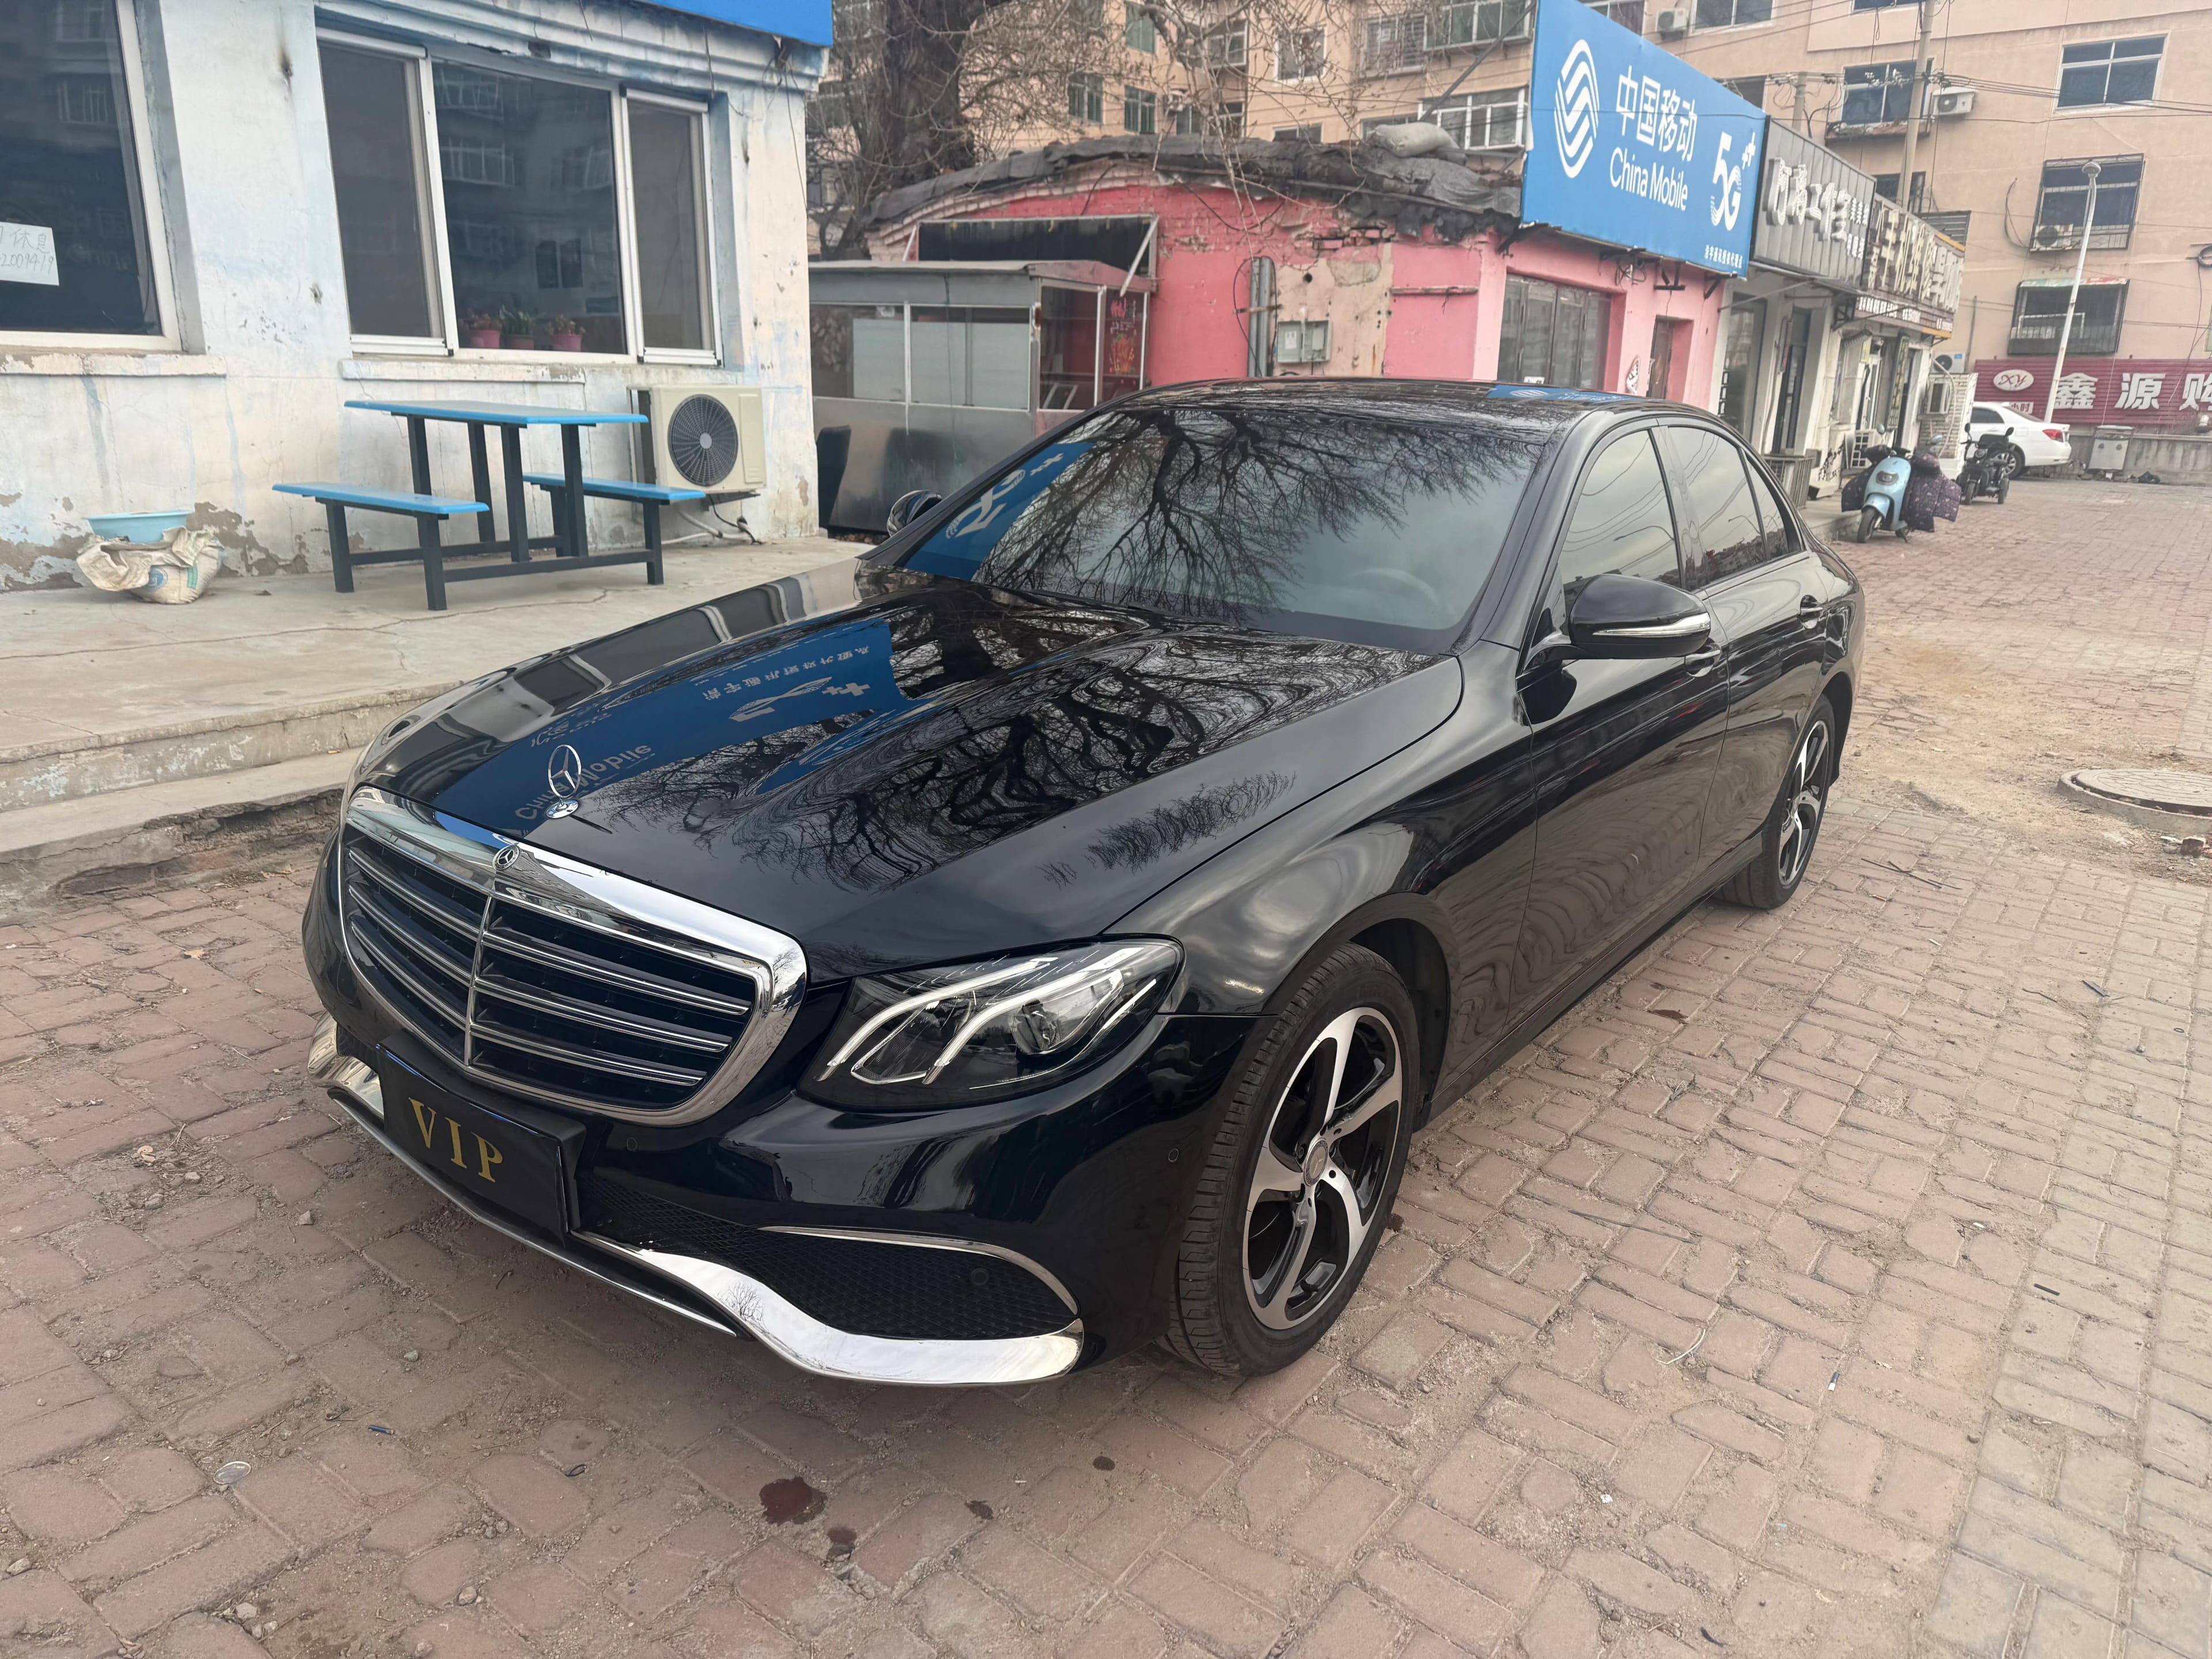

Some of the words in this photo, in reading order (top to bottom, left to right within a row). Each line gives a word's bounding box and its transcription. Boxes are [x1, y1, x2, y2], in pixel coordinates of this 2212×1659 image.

[1616, 65, 1698, 162] 中国移动
[1609, 147, 1647, 198] China
[1650, 161, 1688, 211] Mobile
[408, 1097, 503, 1183] VIP
